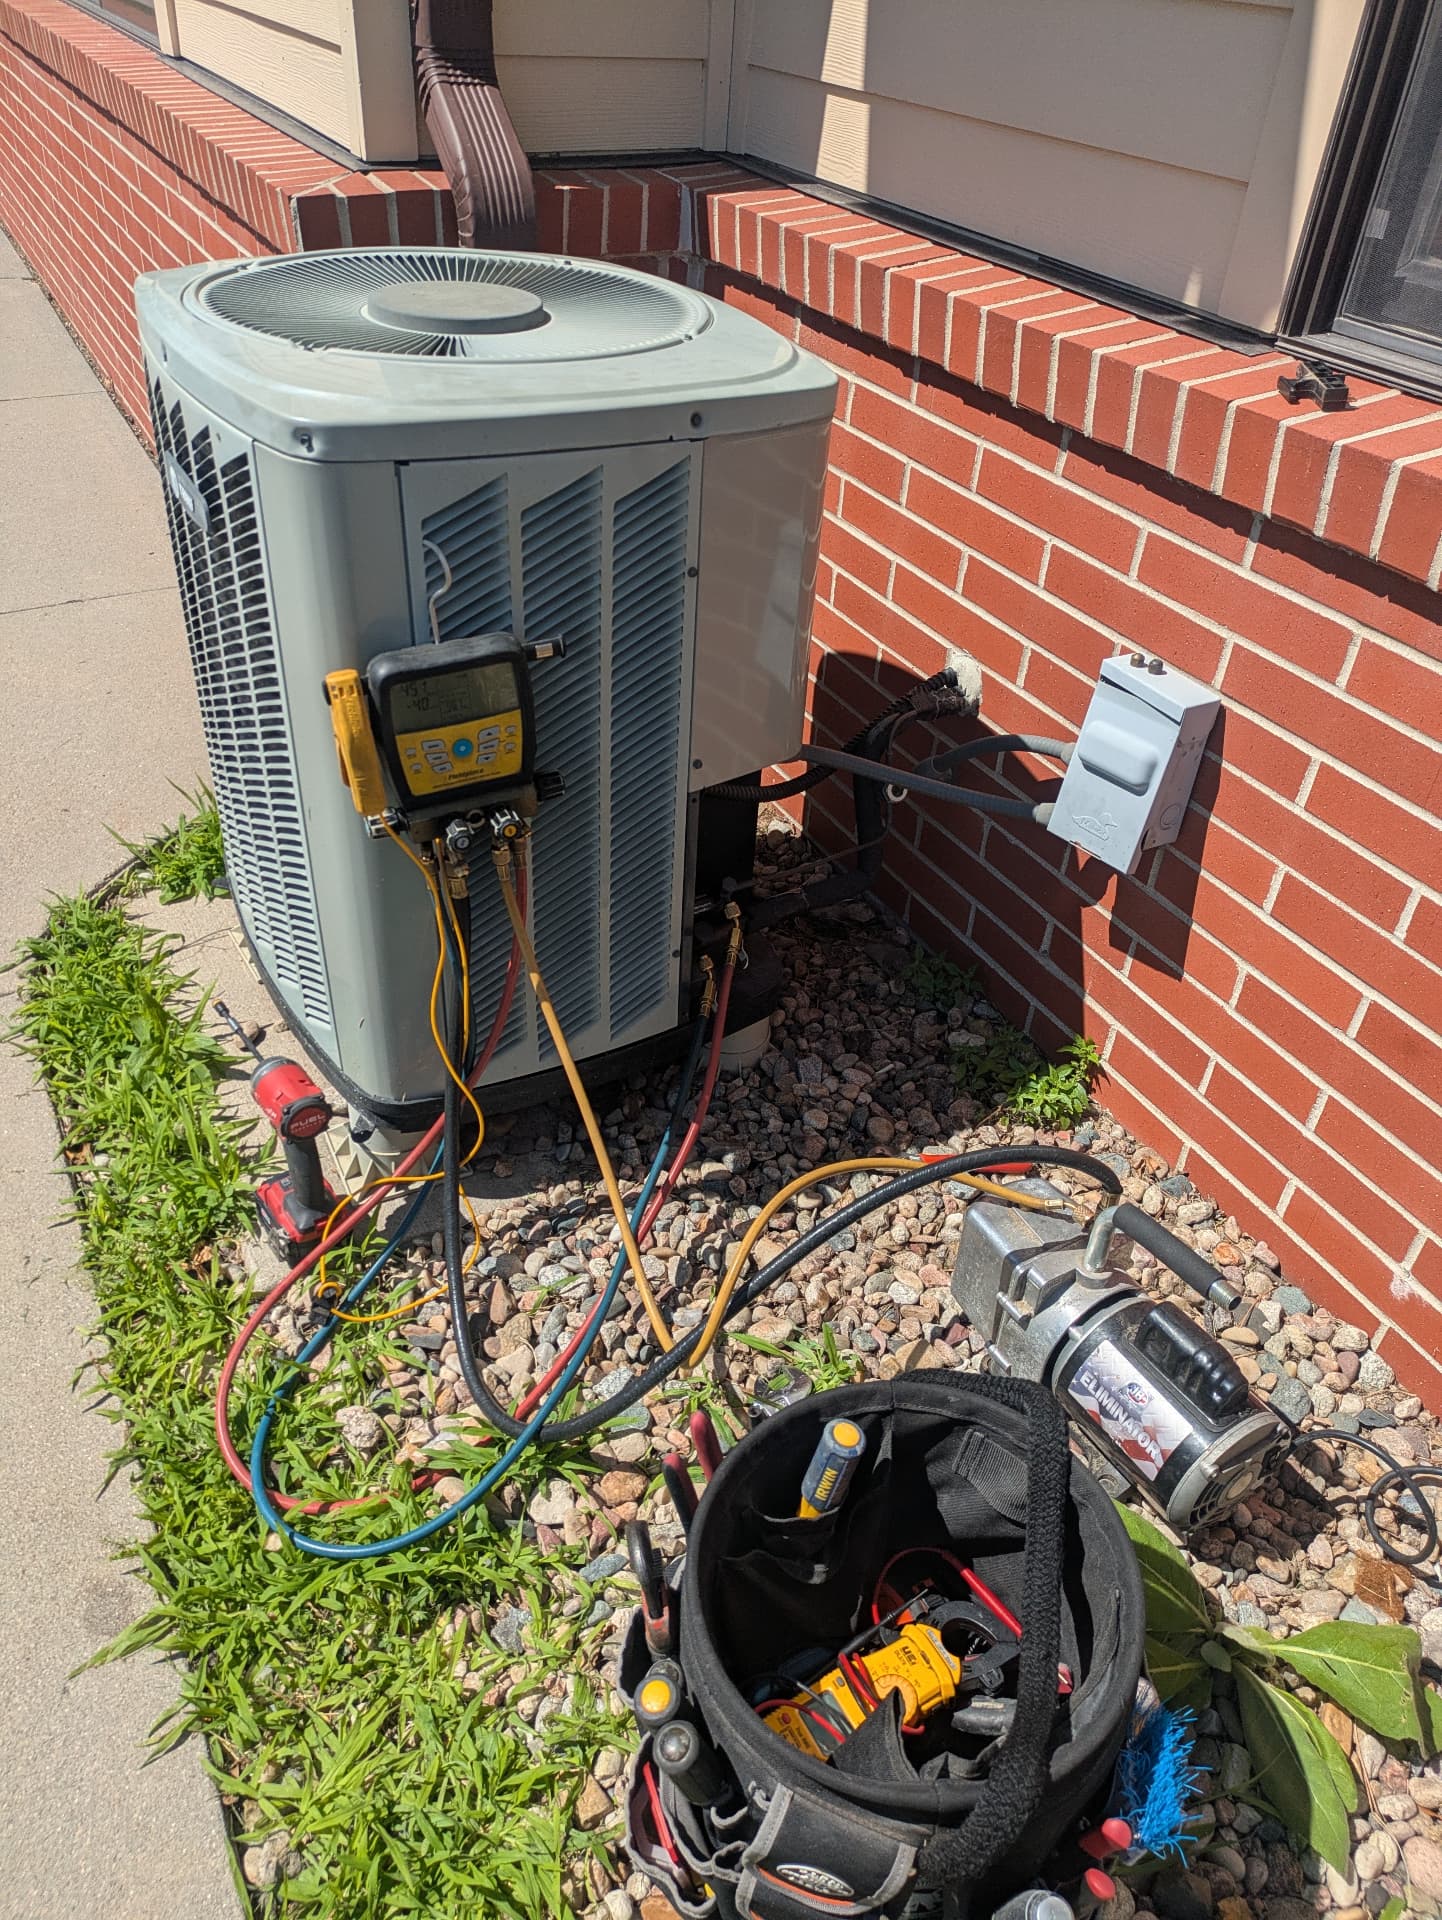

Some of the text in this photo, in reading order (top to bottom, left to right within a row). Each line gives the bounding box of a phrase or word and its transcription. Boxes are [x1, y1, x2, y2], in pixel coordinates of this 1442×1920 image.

[290, 1114, 326, 1129] FUEL
[1080, 1370, 1164, 1470] ELIMINATOR
[814, 1467, 839, 1501] IRWIN
